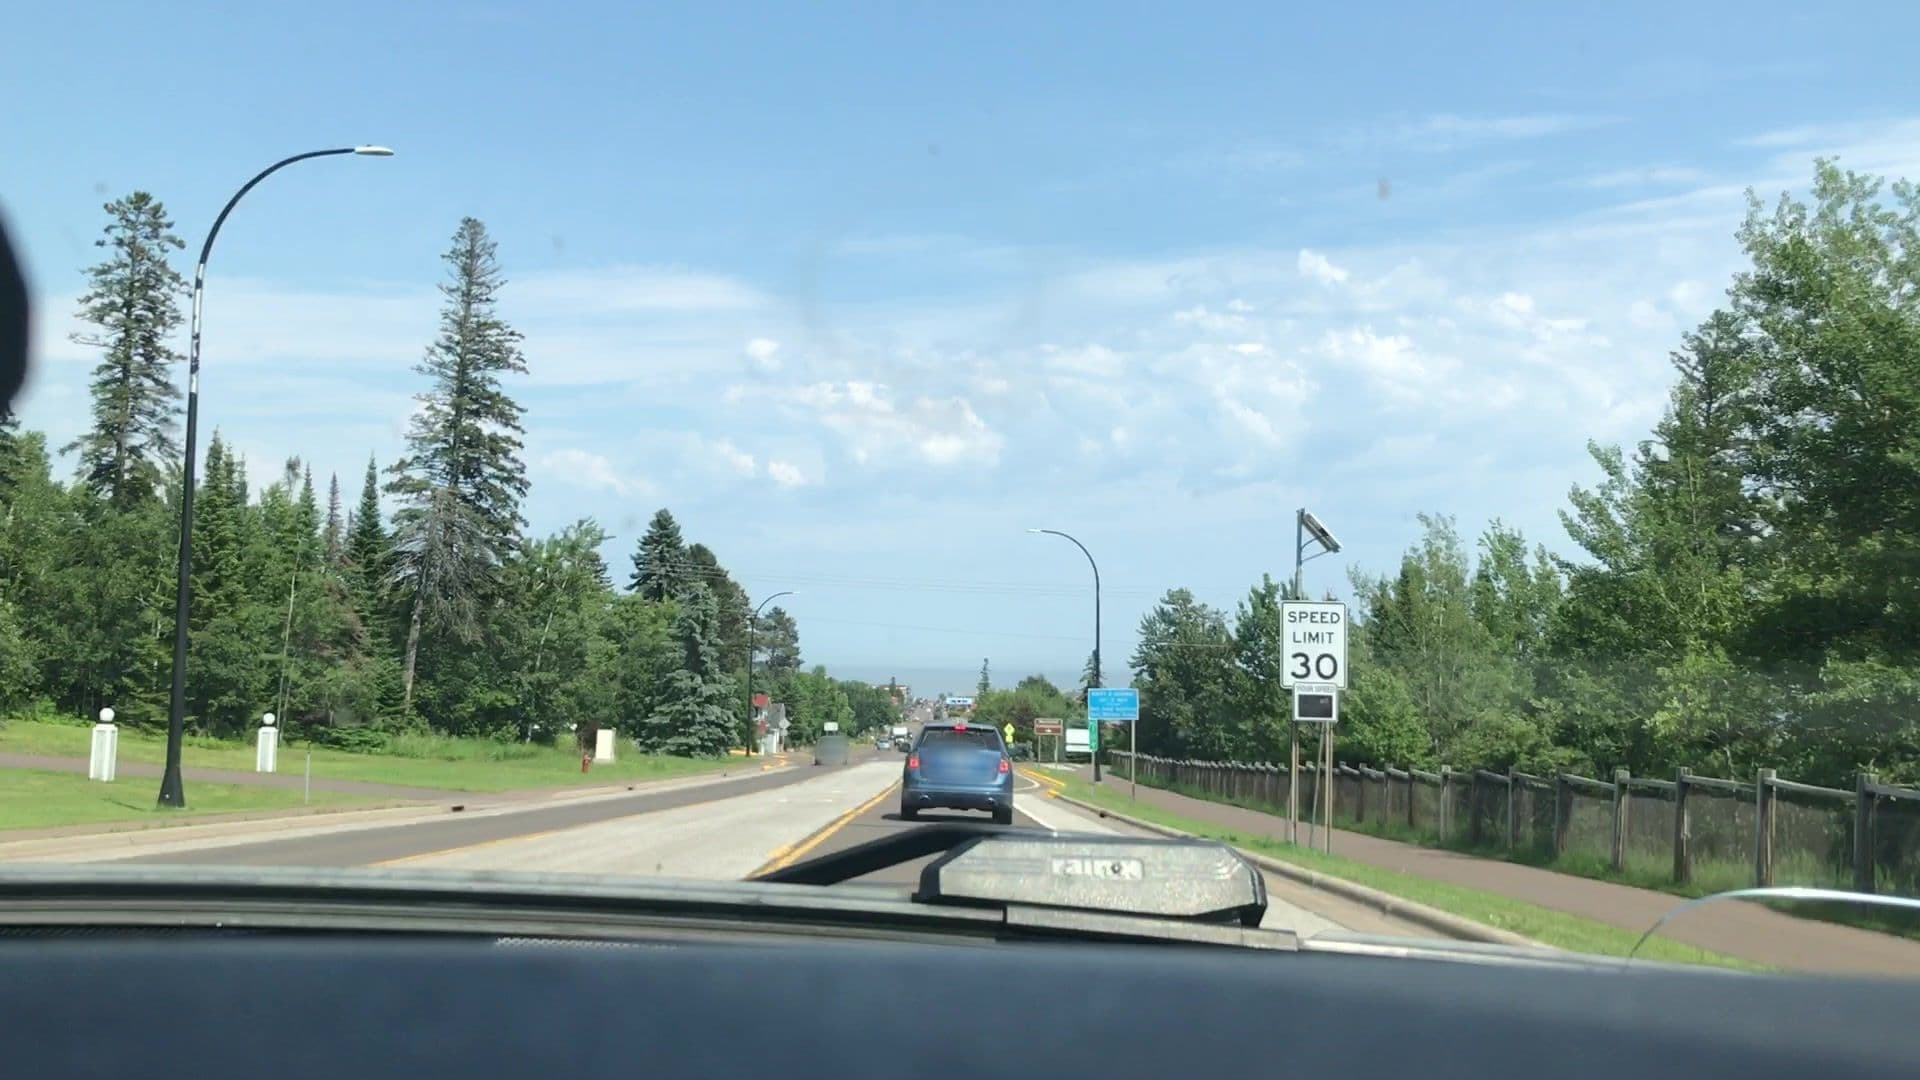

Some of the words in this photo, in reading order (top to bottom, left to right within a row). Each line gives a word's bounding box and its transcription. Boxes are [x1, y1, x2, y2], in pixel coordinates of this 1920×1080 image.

[1288, 611, 1341, 624] SPEED
[1292, 632, 1335, 644] LIMIT
[1291, 652, 1338, 680] 30
